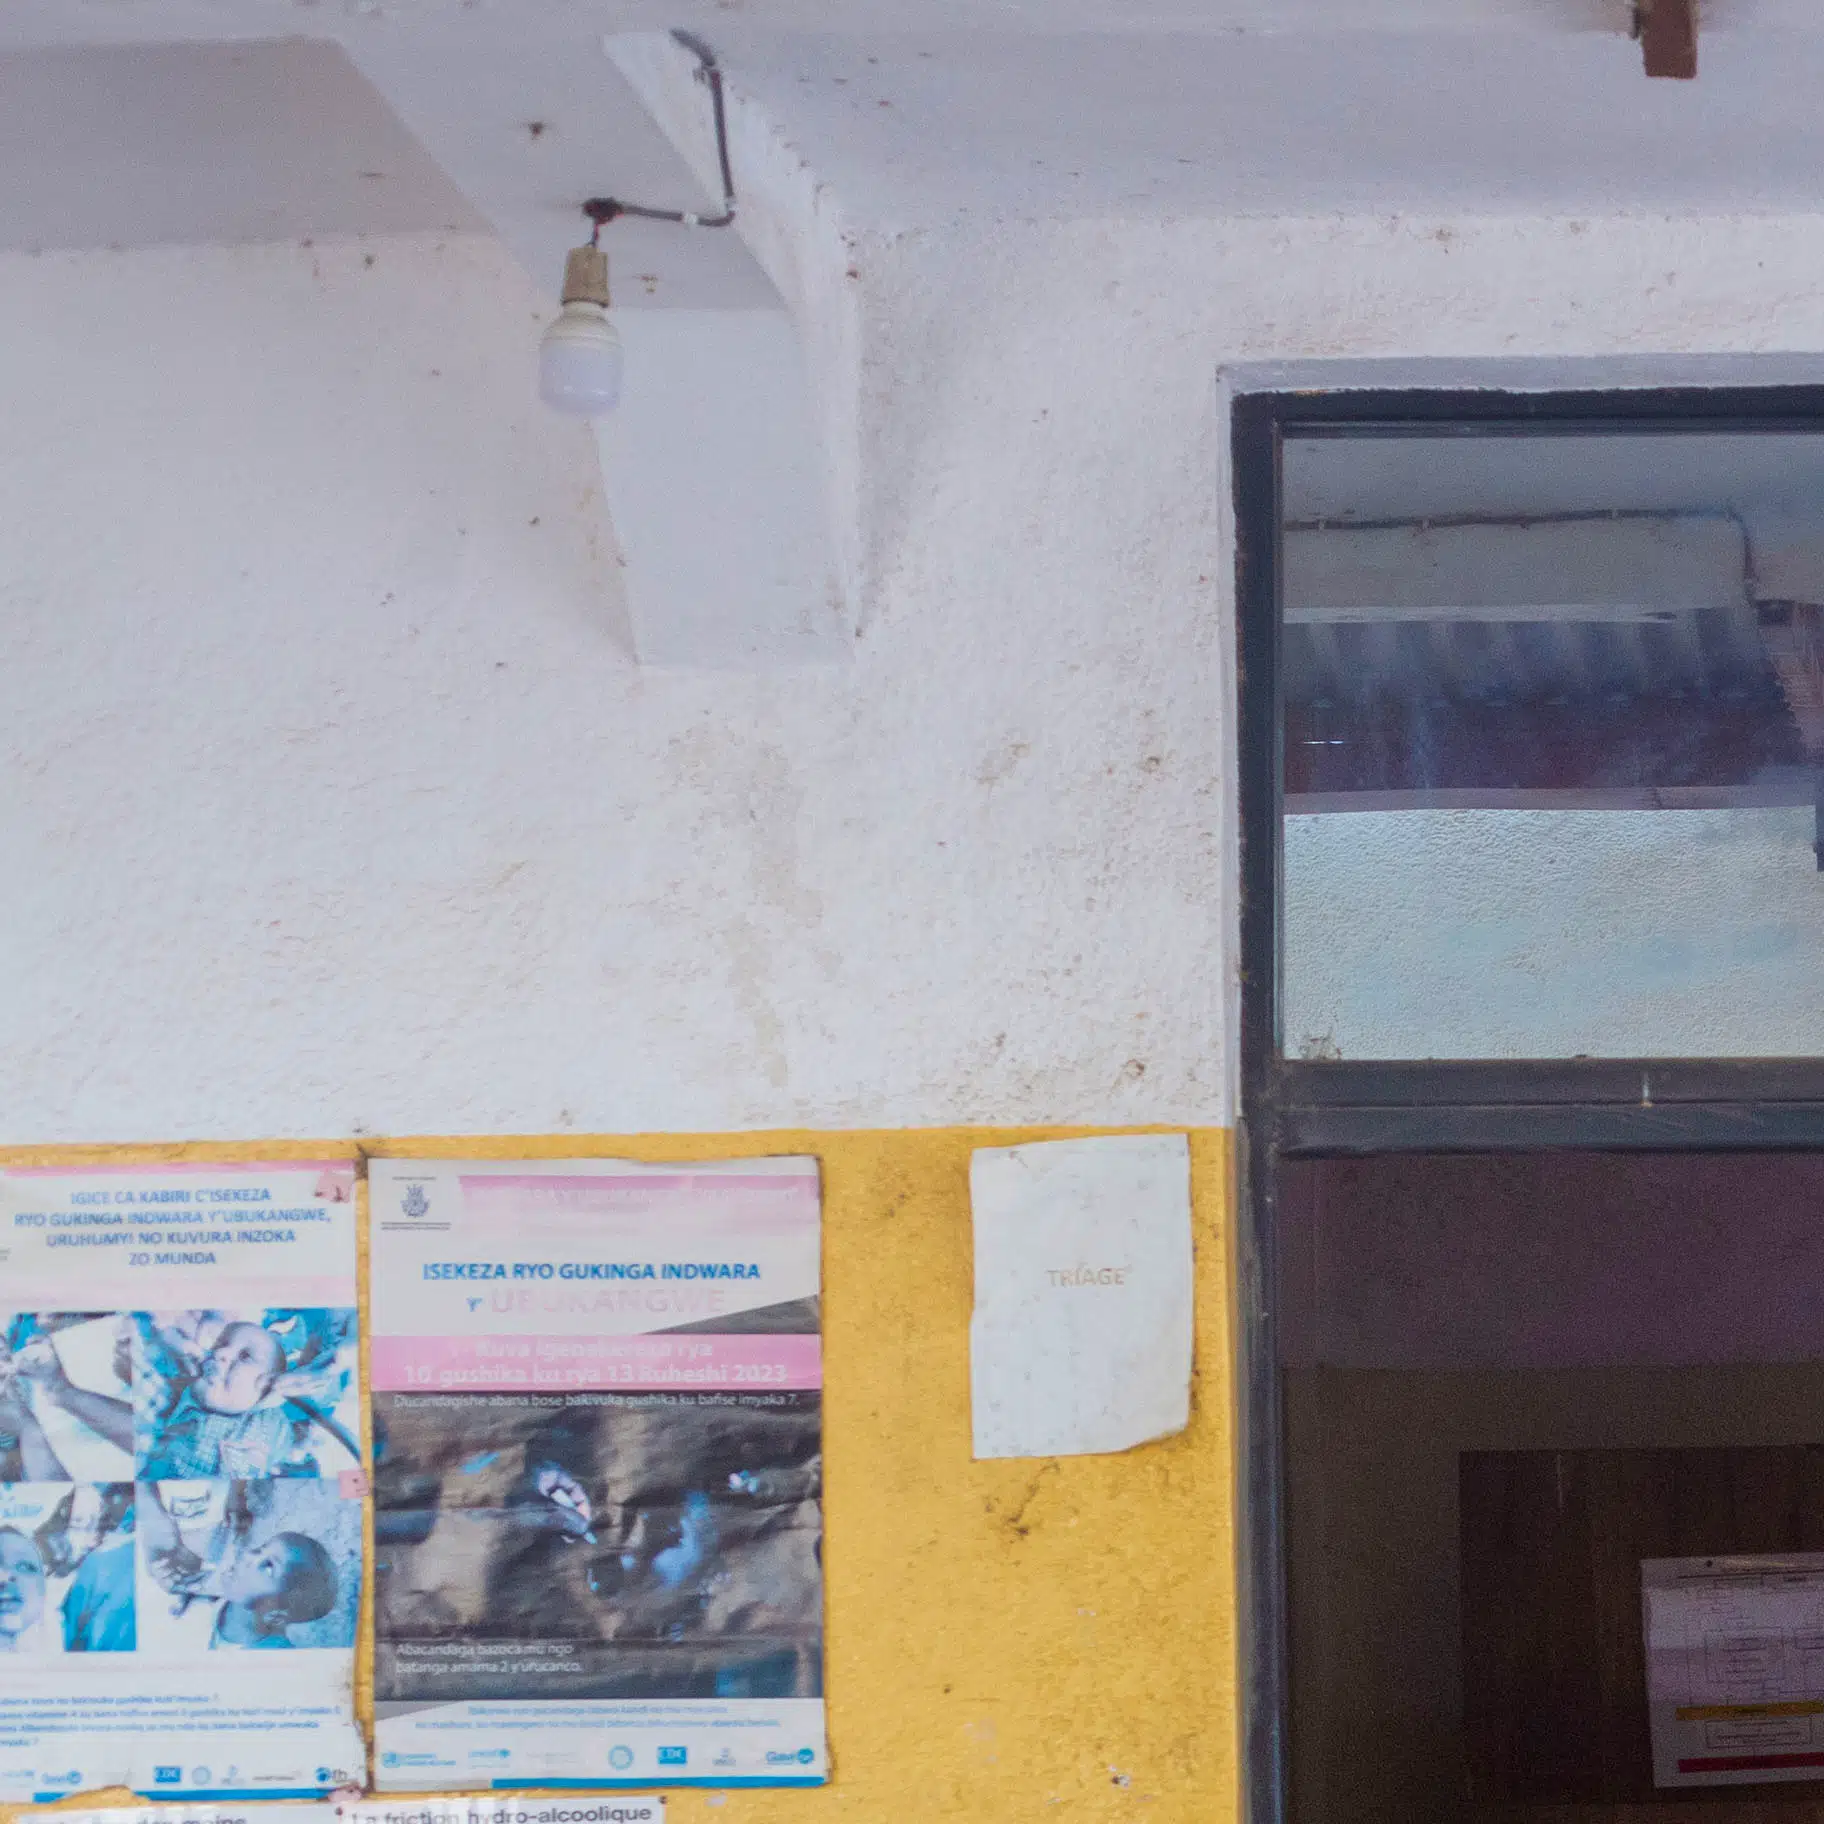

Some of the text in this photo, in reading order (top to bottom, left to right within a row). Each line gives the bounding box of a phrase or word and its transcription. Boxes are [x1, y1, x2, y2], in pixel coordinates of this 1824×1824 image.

[139, 1188, 191, 1204] KABIRI
[14, 1213, 47, 1228] RYO
[50, 1212, 123, 1227] GUKINGA
[127, 1210, 203, 1225] INDWARA
[137, 1231, 161, 1246] NO
[166, 1230, 233, 1245] KUVURA
[236, 1229, 297, 1244] INZOKA
[153, 1250, 217, 1266] MUNDA
[422, 1262, 761, 1280] ISEKEZA RYO GUKINGA INDWARA
[1044, 1267, 1125, 1287] TRIAGE
[608, 1364, 634, 1384] 13
[732, 1364, 789, 1384] 2023
